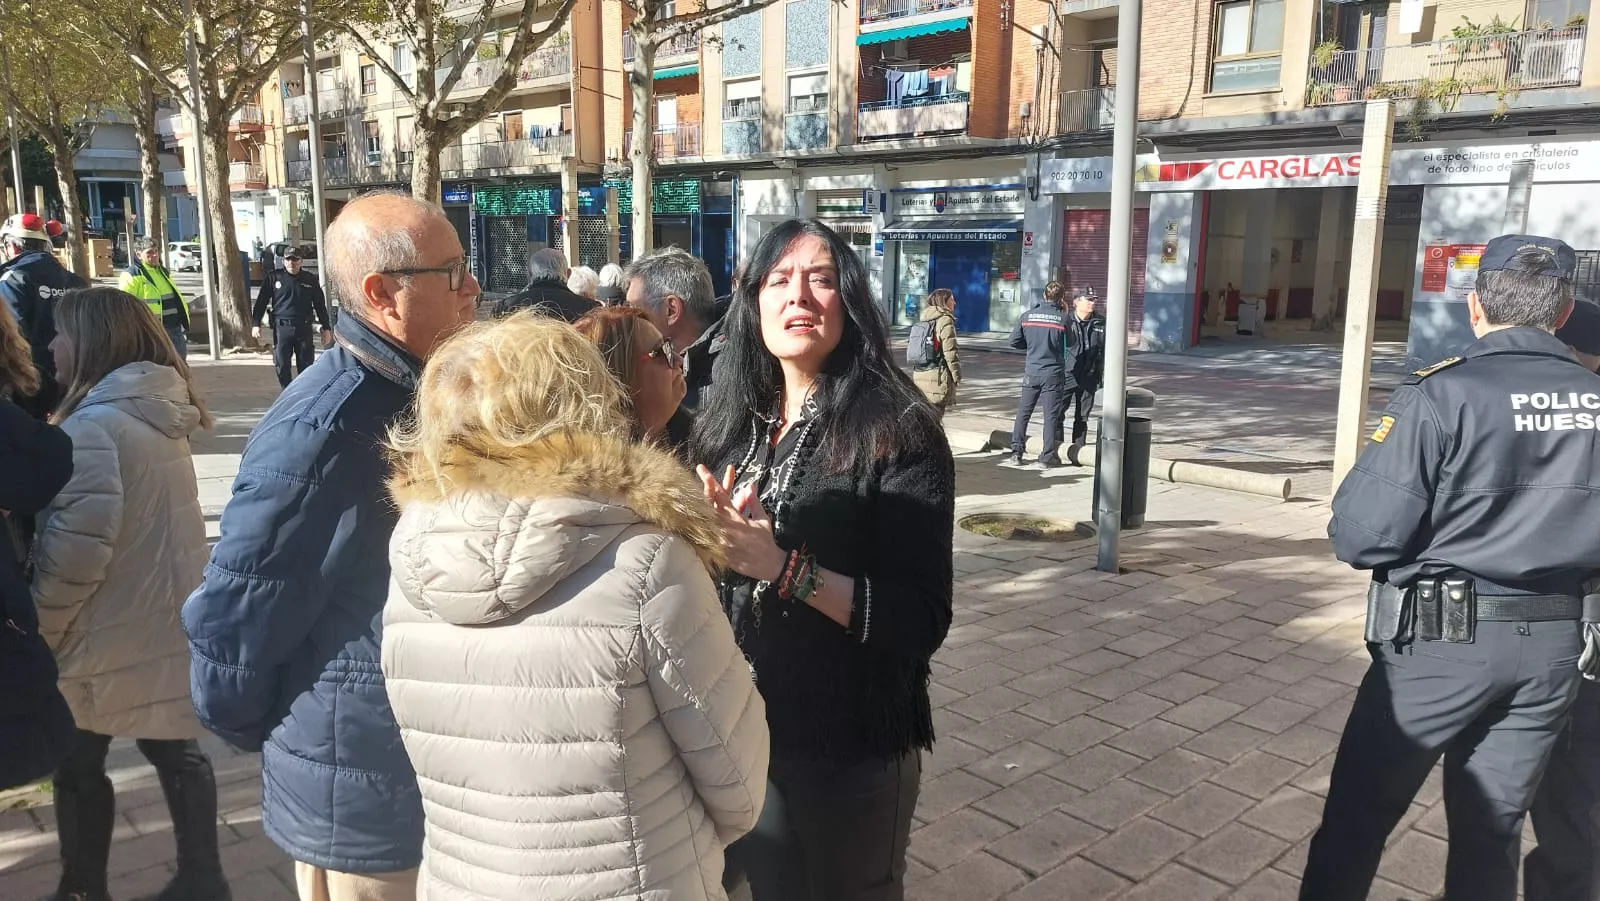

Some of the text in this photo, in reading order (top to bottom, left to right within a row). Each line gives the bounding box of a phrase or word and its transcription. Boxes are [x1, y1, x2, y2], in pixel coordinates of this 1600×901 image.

[1423, 153, 1433, 162] el
[1436, 151, 1500, 163] especialista
[1218, 155, 1361, 179] CARGLAS
[1427, 165, 1442, 174] de
[1445, 164, 1472, 173] todo
[1473, 163, 1493, 174] tipo
[1497, 163, 1511, 171] de
[1051, 170, 1103, 180] 902 20 70 10
[948, 196, 979, 206] Apuestas
[982, 195, 992, 204] del
[995, 194, 1020, 203] Estado
[926, 232, 962, 241] Apuestas
[964, 232, 977, 240] del
[979, 232, 1007, 240] Estado
[1510, 392, 1600, 410] POLIC
[1514, 412, 1600, 432] HUES
